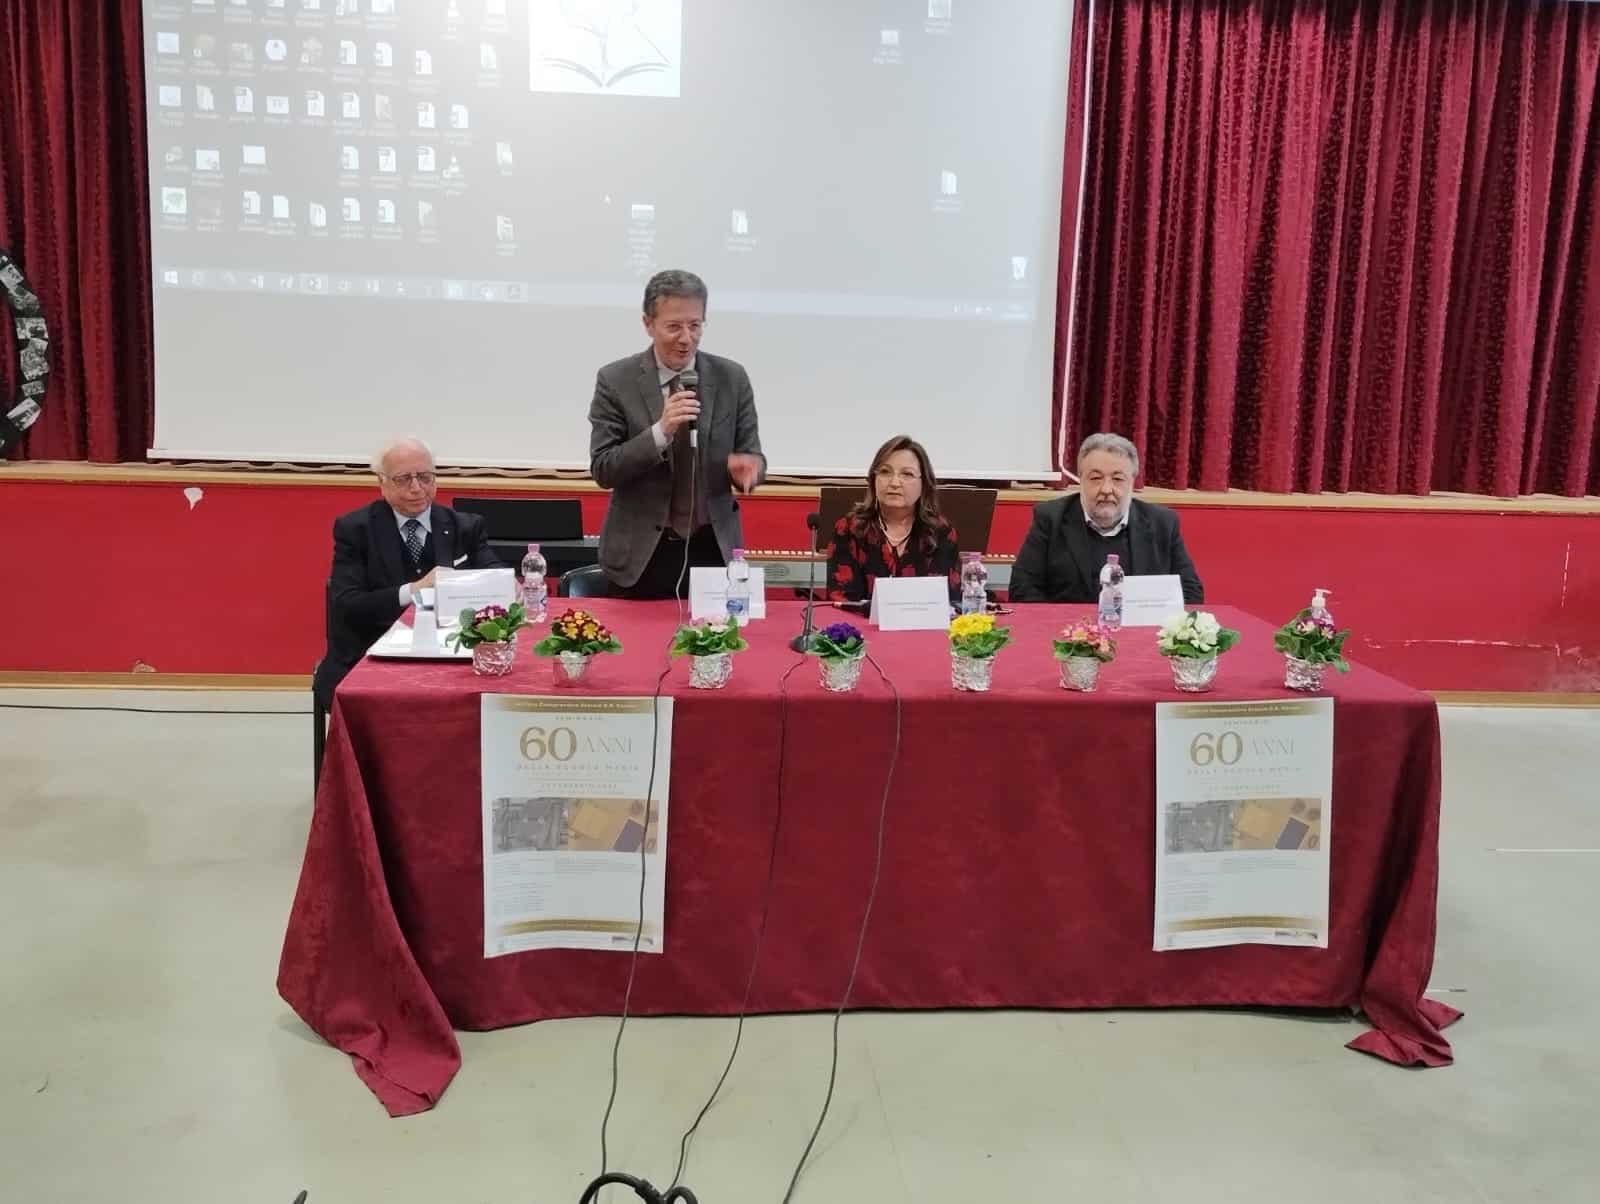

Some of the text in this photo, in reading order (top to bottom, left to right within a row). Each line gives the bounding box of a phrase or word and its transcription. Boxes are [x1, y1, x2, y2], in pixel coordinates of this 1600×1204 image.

[519, 726, 632, 762] 60 ANNI
[1190, 731, 1296, 766] 60 ANNI
